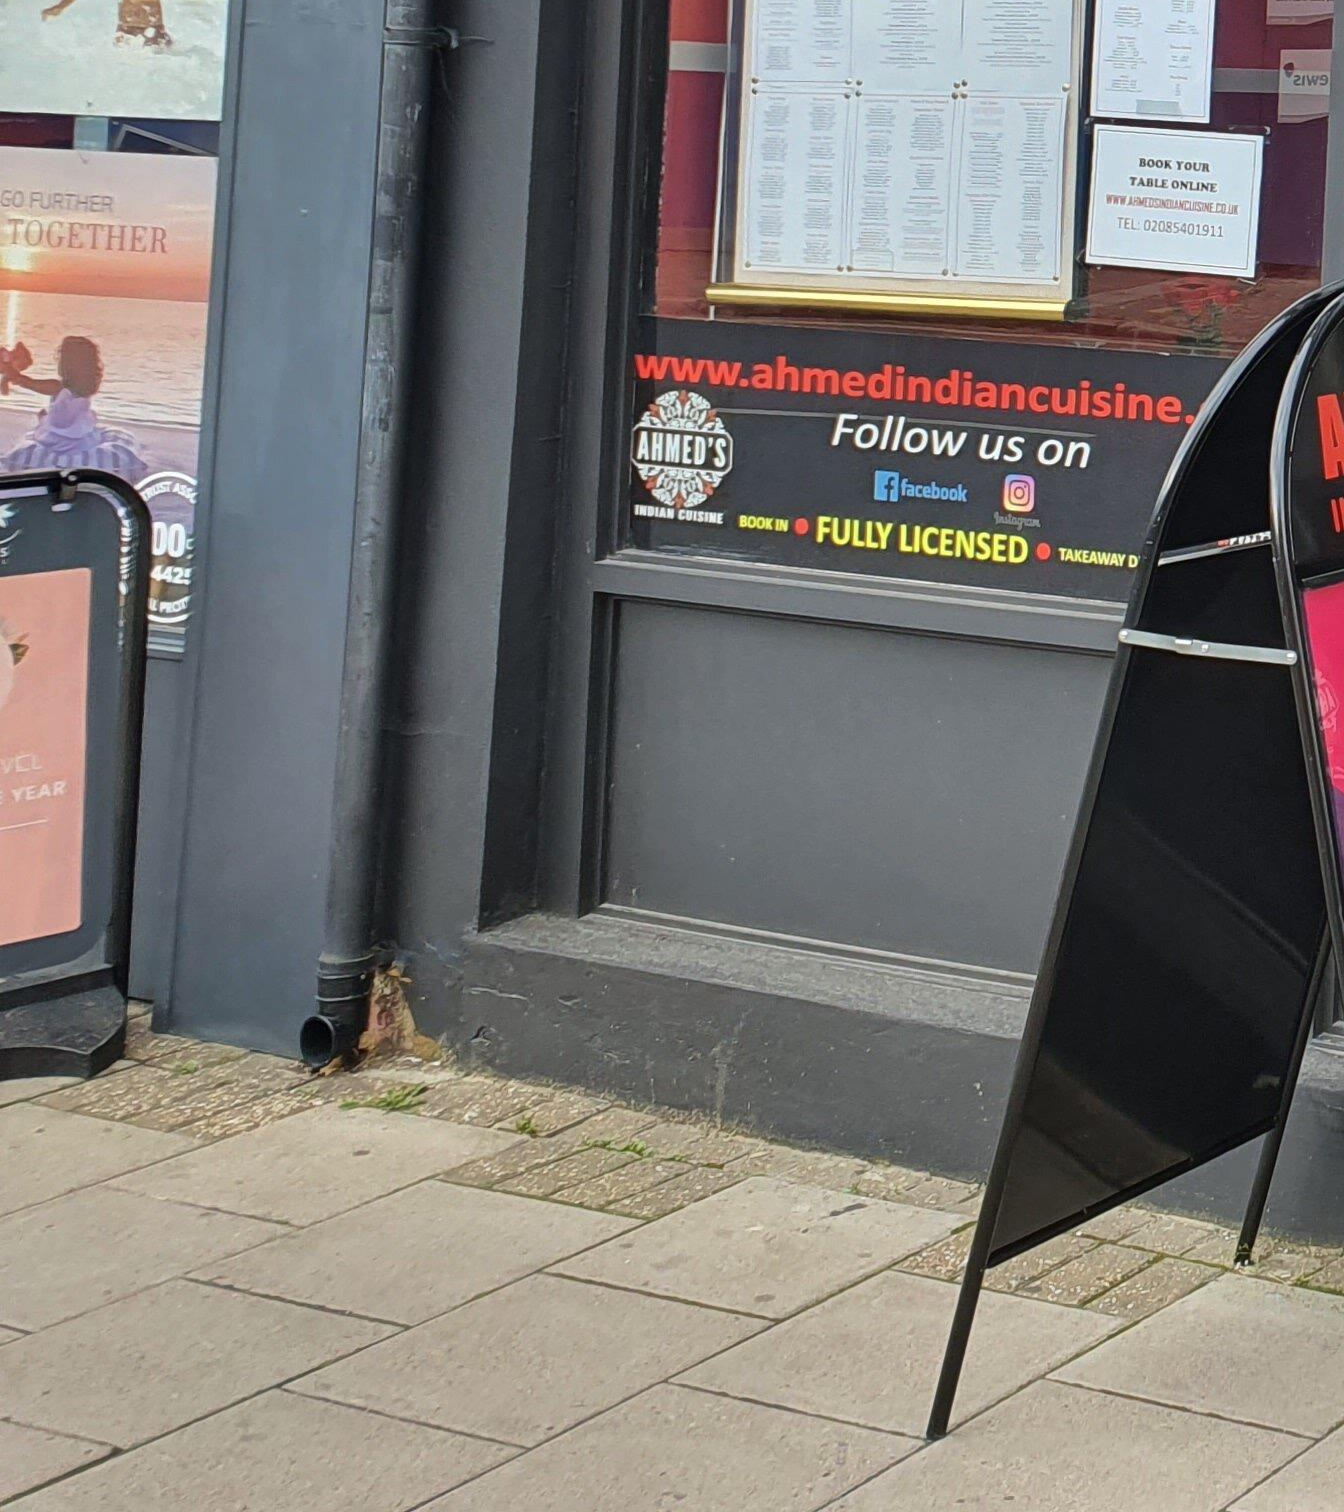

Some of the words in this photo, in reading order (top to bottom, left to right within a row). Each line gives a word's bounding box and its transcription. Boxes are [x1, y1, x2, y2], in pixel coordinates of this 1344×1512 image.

[1139, 158, 1172, 170] BOOK
[1176, 161, 1210, 173] YOUR
[1130, 177, 1168, 189] TABLE
[1171, 179, 1218, 193] ONLINE
[0, 190, 24, 208] GO
[30, 191, 113, 212] FURTHER
[8, 218, 167, 253] TOGETHER
[1117, 217, 1140, 231] TEL:
[1143, 219, 1224, 237] 02085401911
[635, 354, 1201, 424] www.ahmedindiancuisine.
[636, 430, 728, 469] AHMED'S
[831, 413, 967, 457] Follow
[979, 433, 1025, 464] us
[1037, 438, 1091, 469] on
[900, 478, 968, 503] facebook
[634, 503, 676, 521] INDIAN
[678, 507, 724, 526] CUISINE
[738, 514, 772, 531] BOOK
[774, 517, 788, 533] IN
[993, 511, 1041, 531] Instagram
[815, 515, 893, 550] FULLY
[899, 523, 1028, 564] LICENSED
[1058, 546, 1125, 568] TAKEAWAY
[12, 780, 68, 802] YEAR
